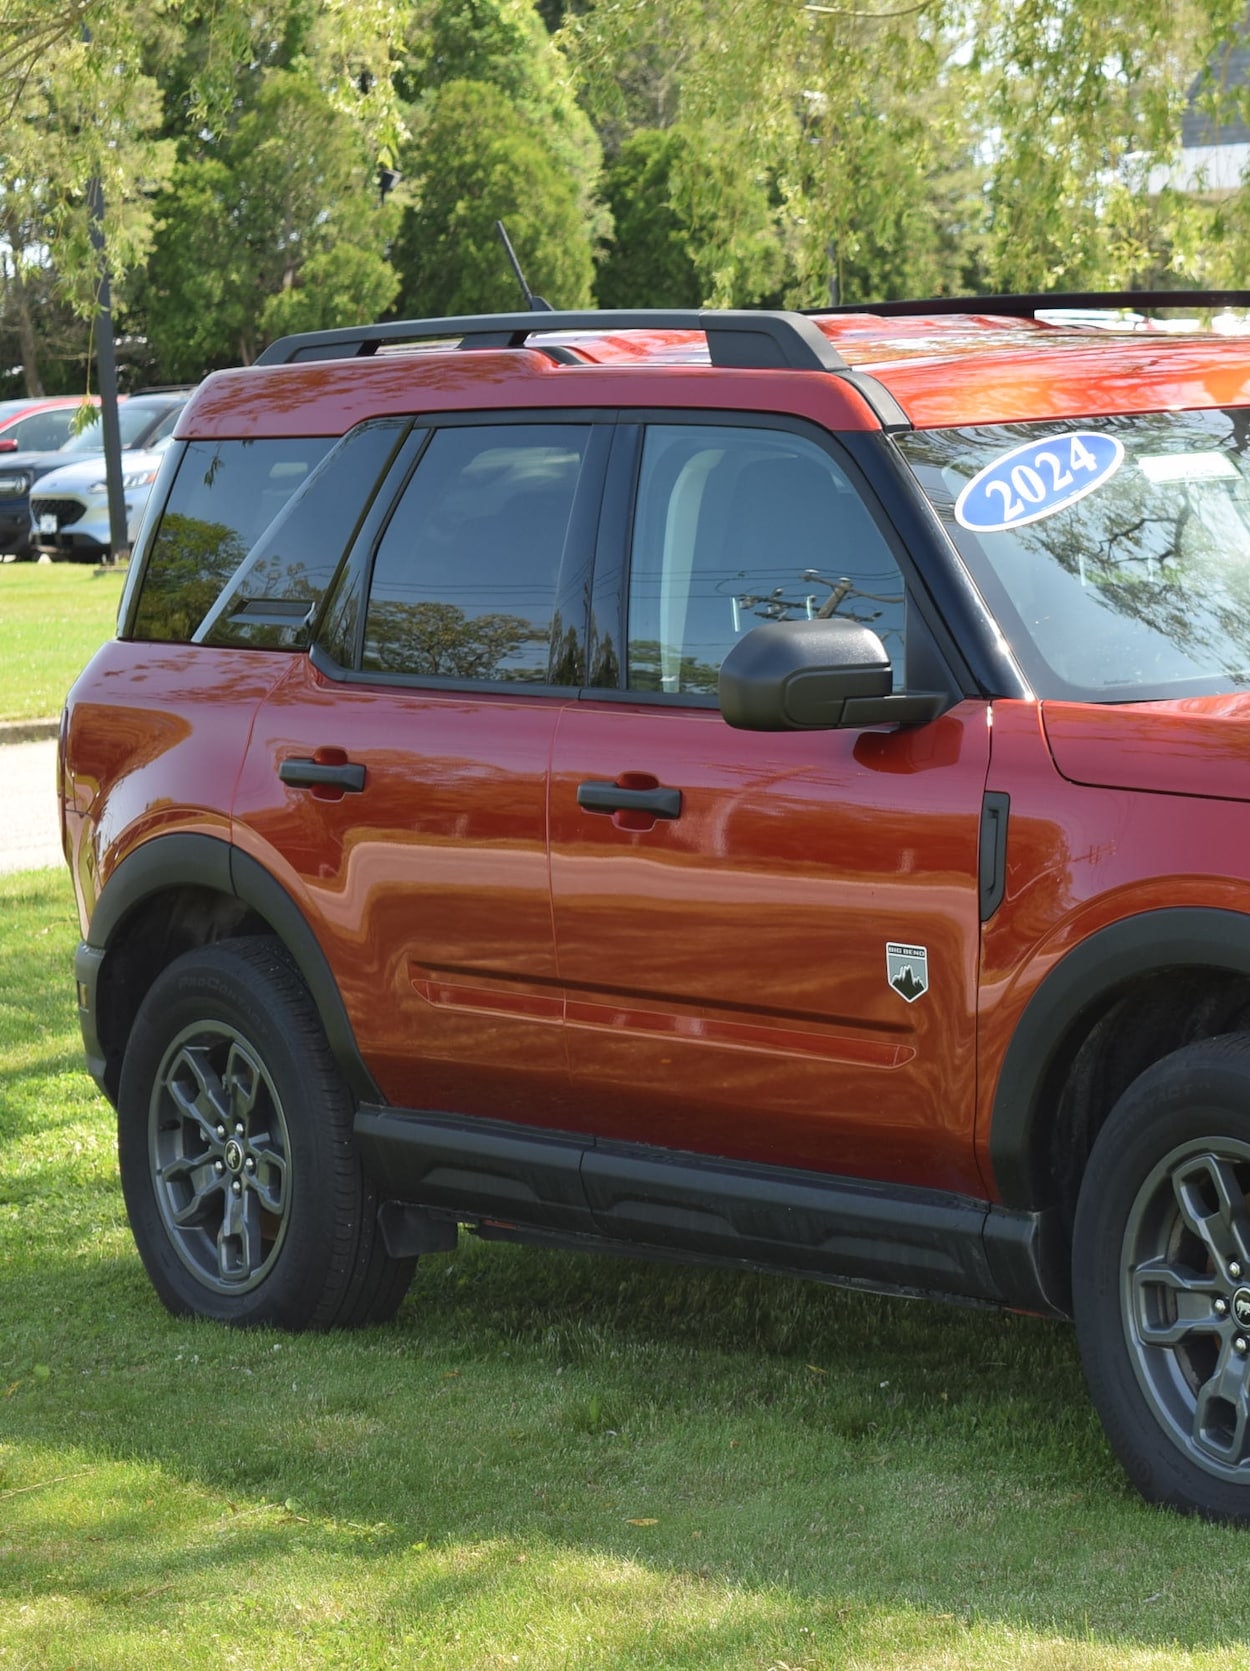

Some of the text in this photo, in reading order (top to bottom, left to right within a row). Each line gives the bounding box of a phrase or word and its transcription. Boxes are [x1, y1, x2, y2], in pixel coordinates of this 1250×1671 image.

[985, 435, 1098, 522] 2024
[888, 946, 925, 957] BIG BEND
